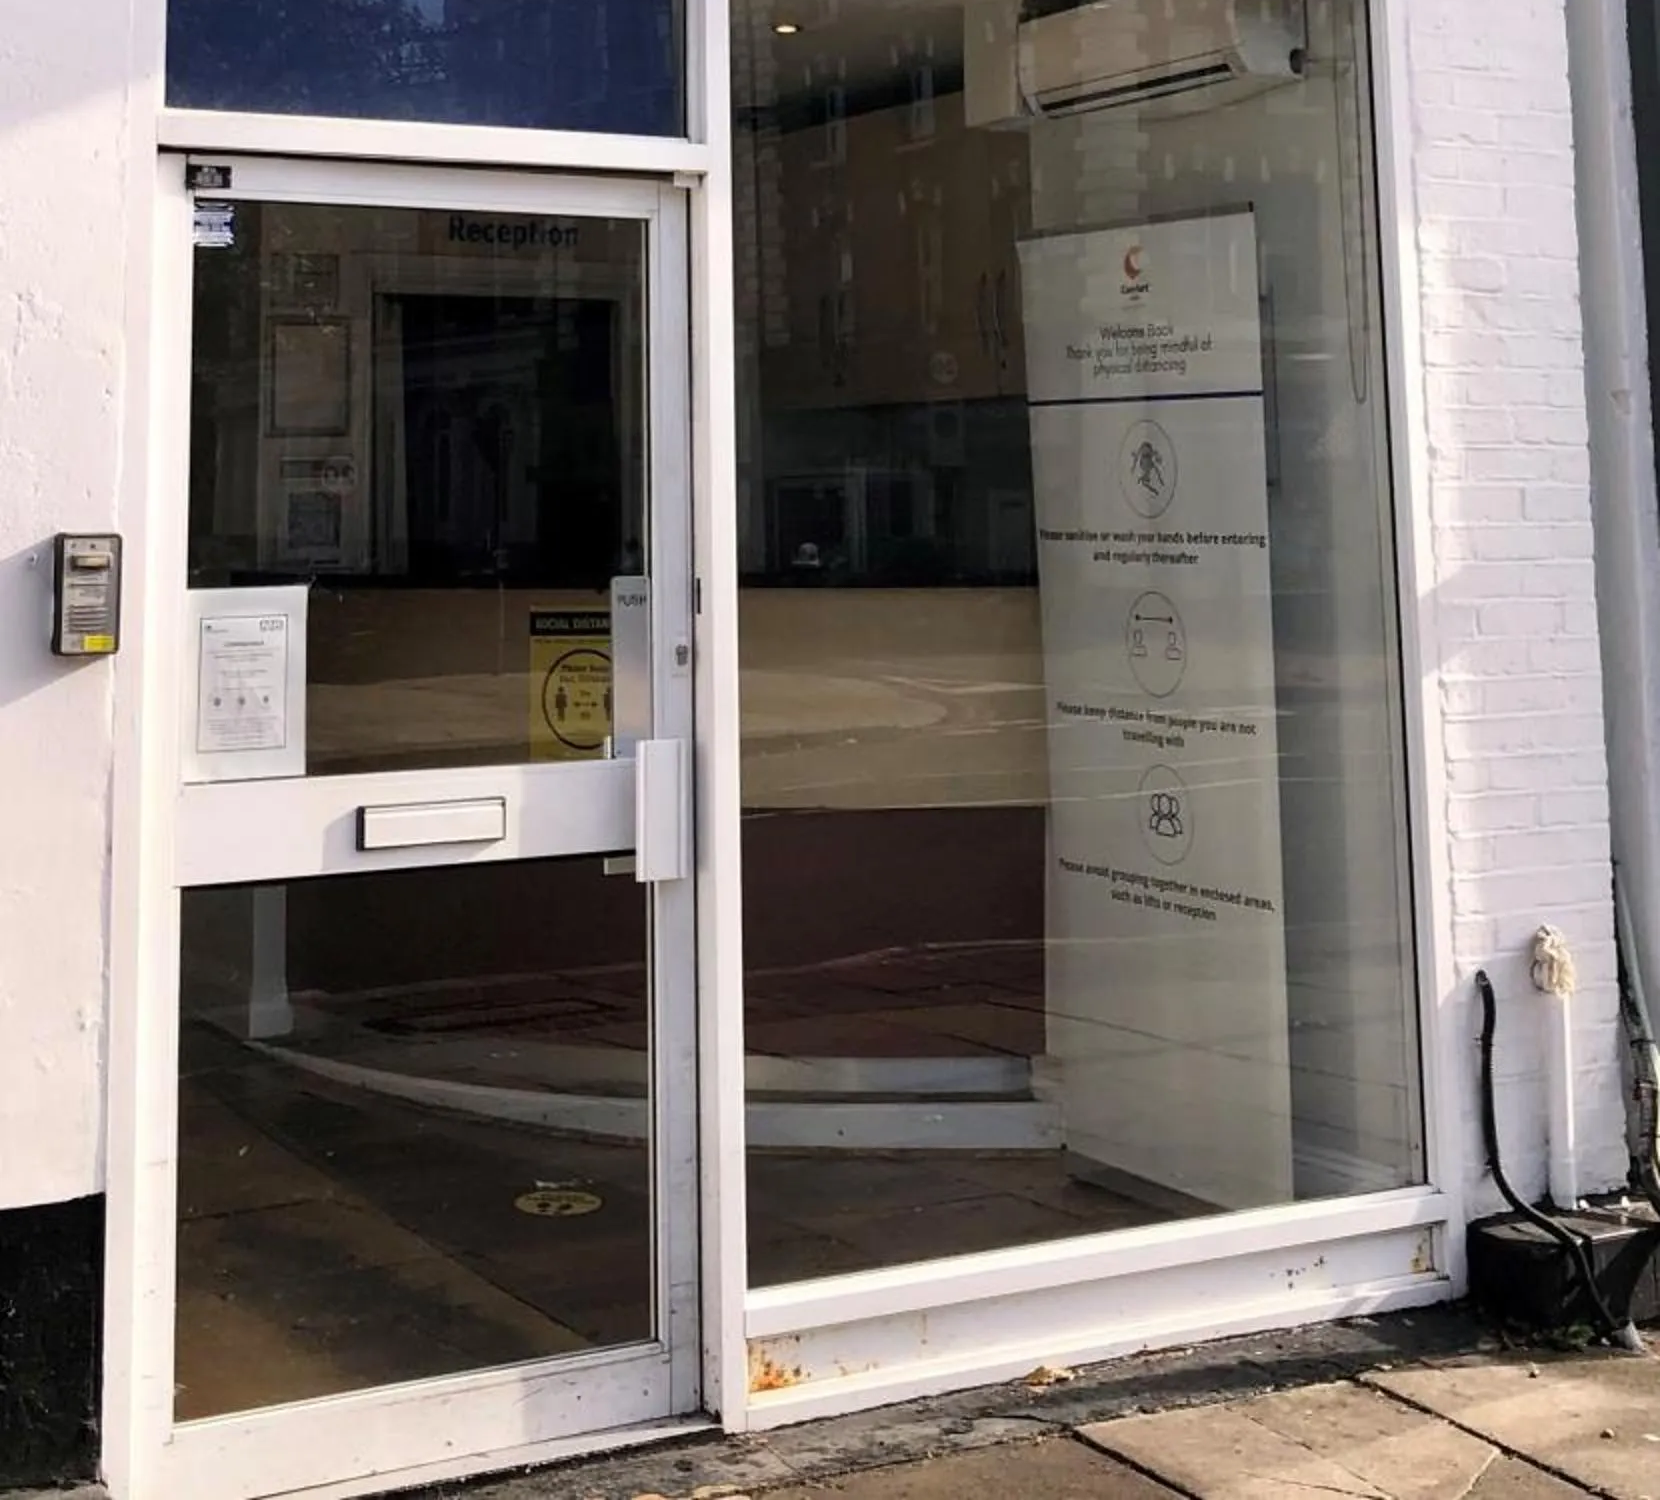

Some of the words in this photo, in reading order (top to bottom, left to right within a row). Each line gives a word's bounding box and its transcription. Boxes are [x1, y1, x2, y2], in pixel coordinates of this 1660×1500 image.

[448, 214, 580, 251] Reception
[1186, 531, 1219, 545] before
[1221, 532, 1267, 548] entering
[1093, 548, 1111, 562] and
[617, 593, 648, 608] PUSH
